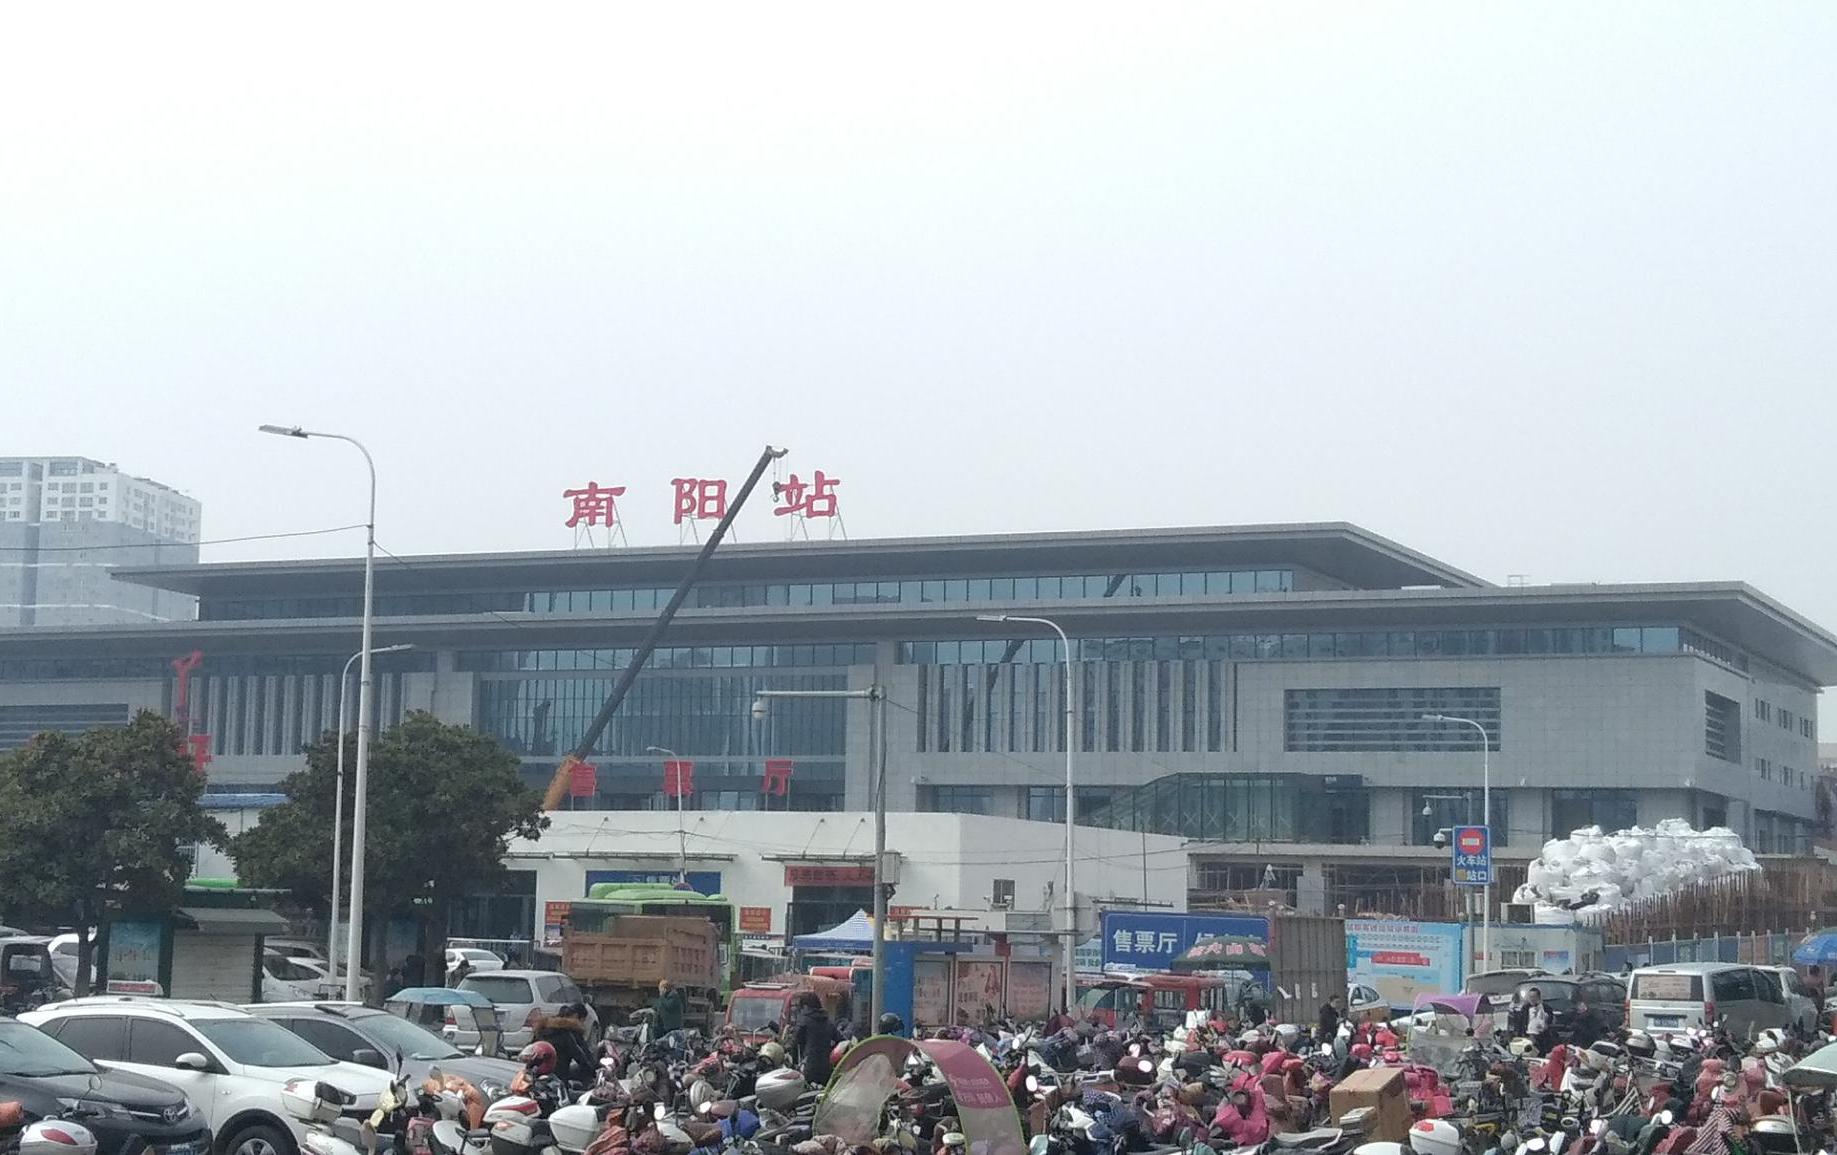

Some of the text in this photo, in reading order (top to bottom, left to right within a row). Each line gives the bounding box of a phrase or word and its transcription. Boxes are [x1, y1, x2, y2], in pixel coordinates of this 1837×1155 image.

[563, 470, 841, 528] 南阳站
[1457, 855, 1487, 867] 火车站
[1456, 869, 1487, 881] 站口
[1113, 928, 1178, 954] 售票厅
